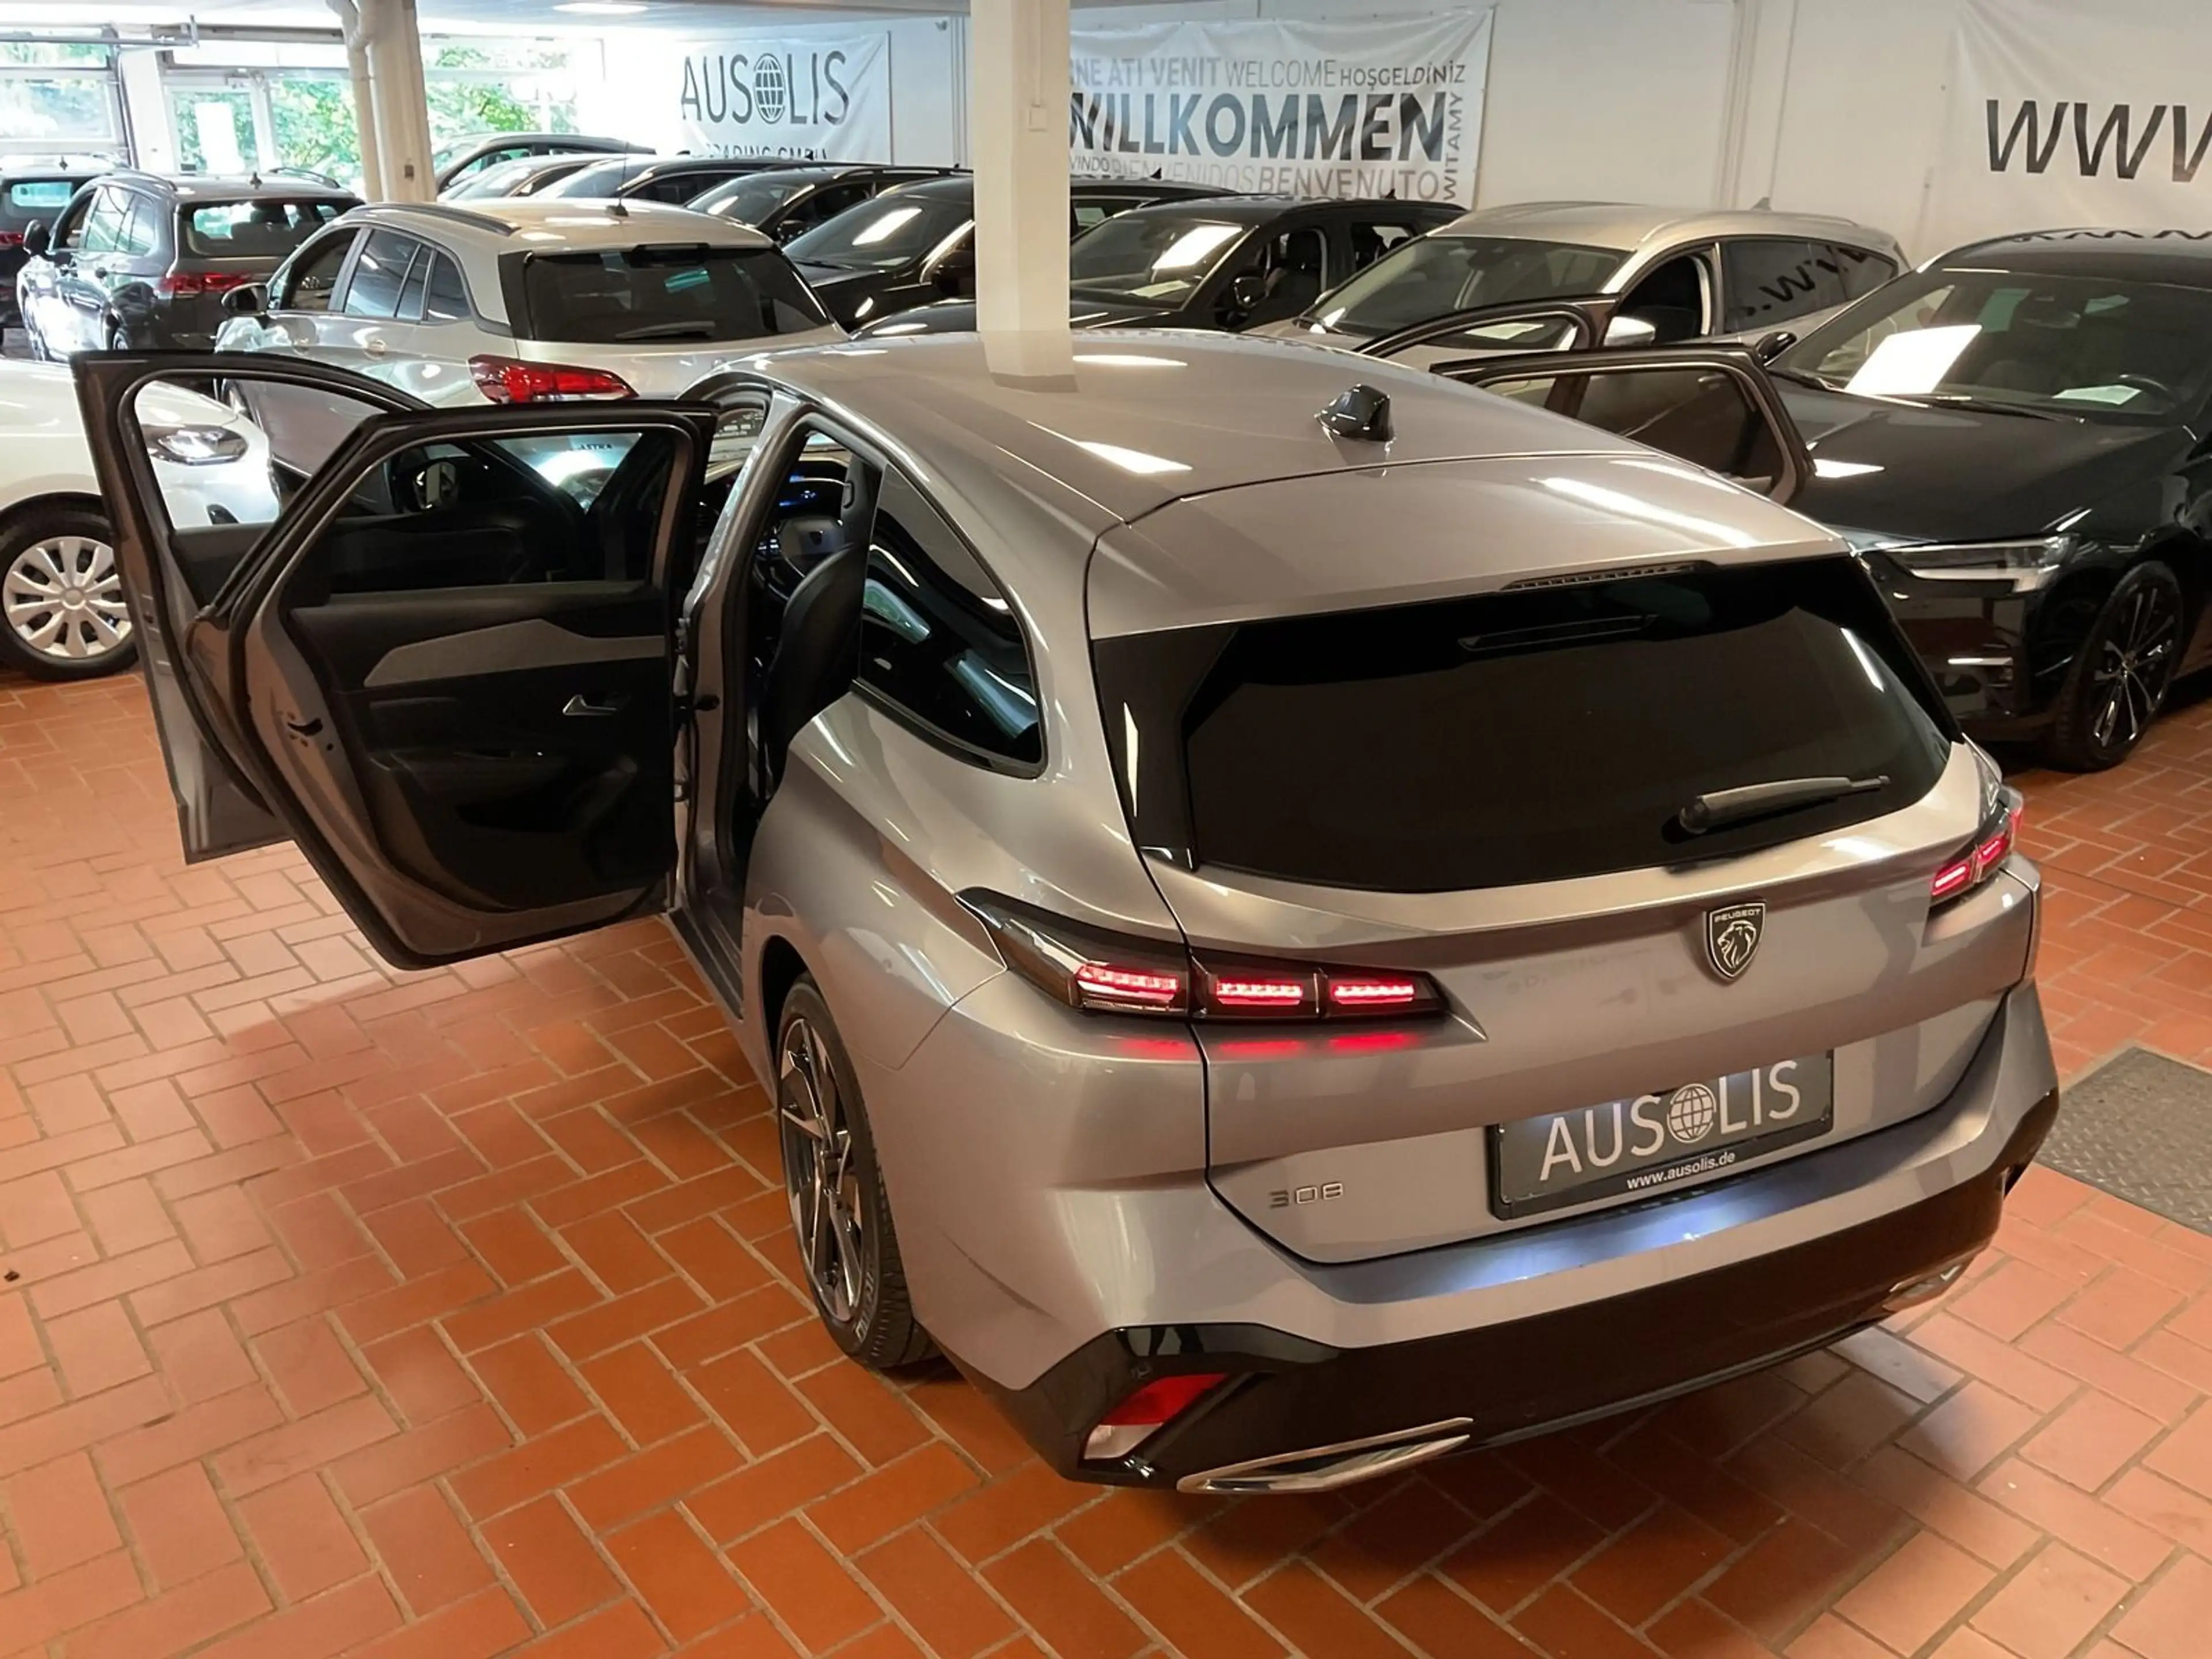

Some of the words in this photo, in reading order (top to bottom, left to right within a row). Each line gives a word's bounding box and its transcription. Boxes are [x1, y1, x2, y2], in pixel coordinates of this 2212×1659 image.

[1152, 56, 1221, 87] VENIT
[1226, 59, 1336, 88] WELCOME
[1443, 91, 1464, 201] WITAMY
[1259, 166, 1440, 200] BENVENUTO
[1714, 908, 1761, 923] PEUGEOT
[1626, 1151, 1735, 1190] www.ausolis.de
[1269, 1181, 1343, 1209] 308
